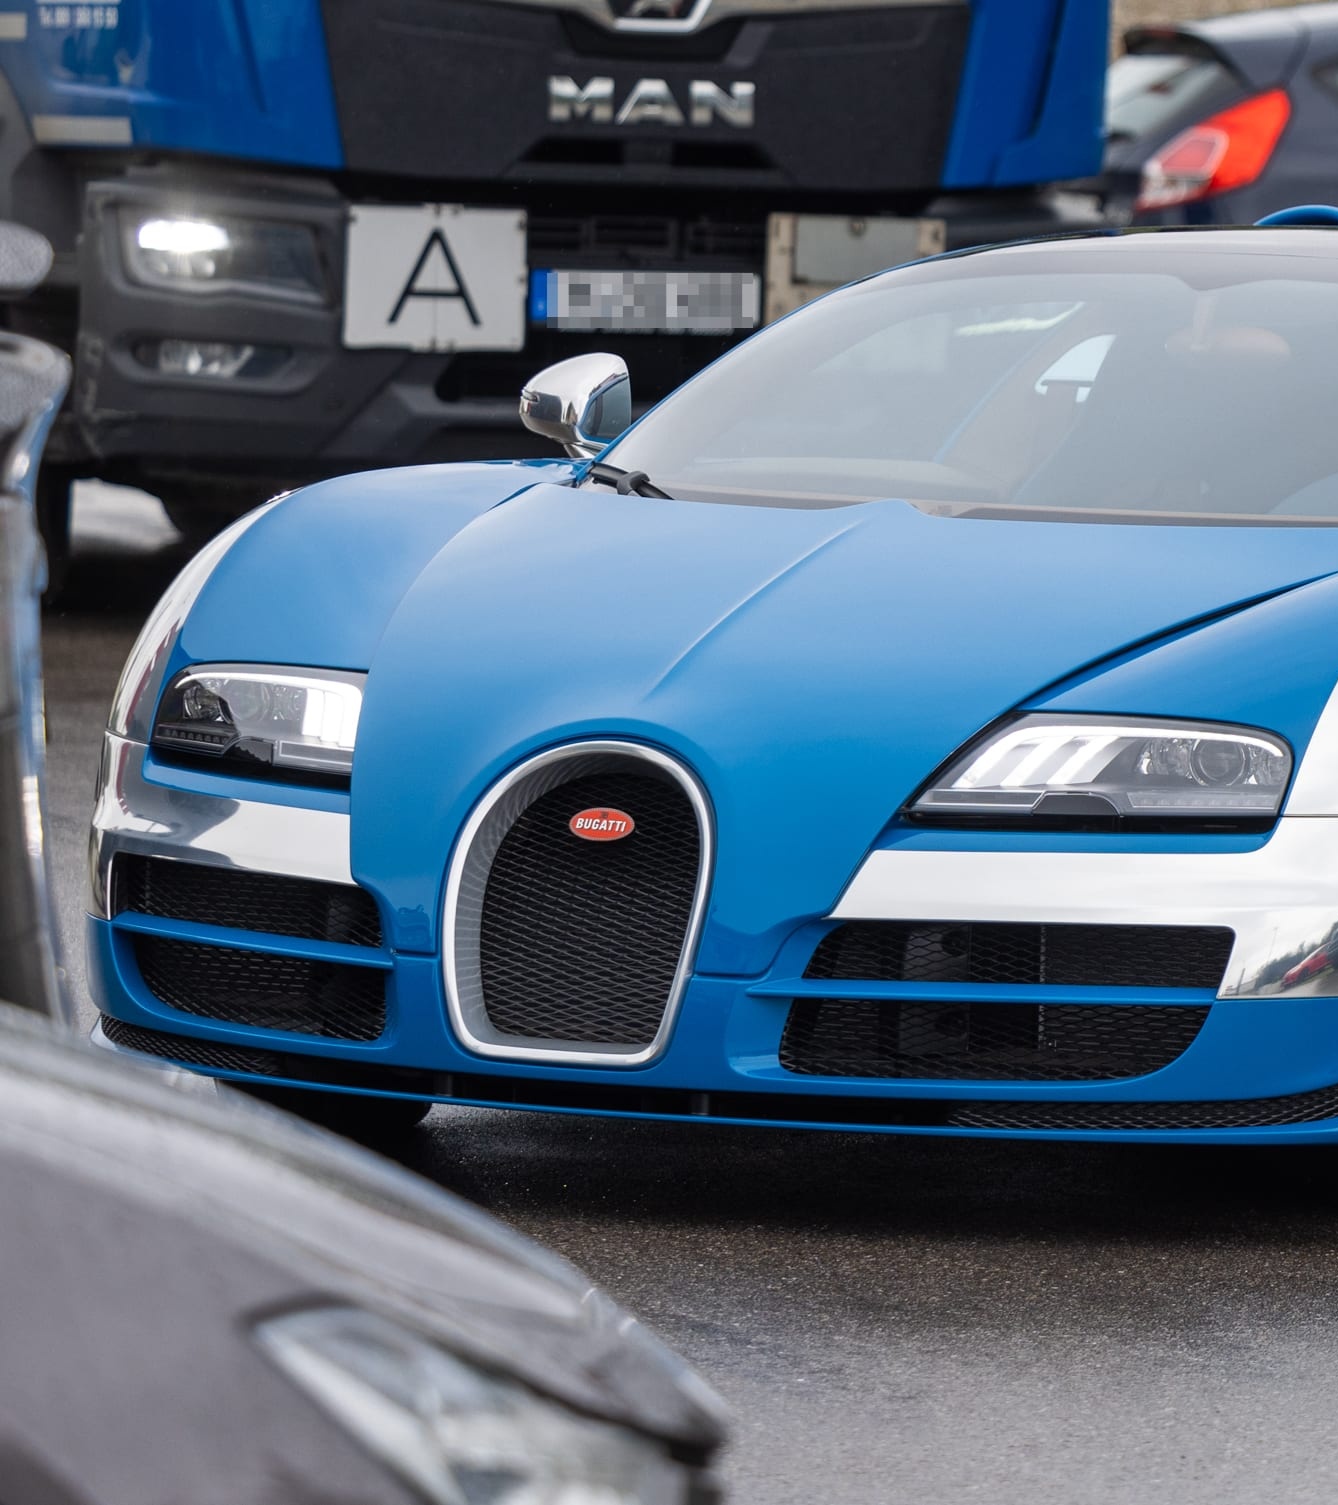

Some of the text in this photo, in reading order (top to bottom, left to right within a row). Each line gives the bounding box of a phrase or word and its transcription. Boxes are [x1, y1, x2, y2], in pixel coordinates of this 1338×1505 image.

[548, 75, 755, 127] MAN
[387, 227, 482, 325] A
[576, 818, 626, 832] BUGATTI
